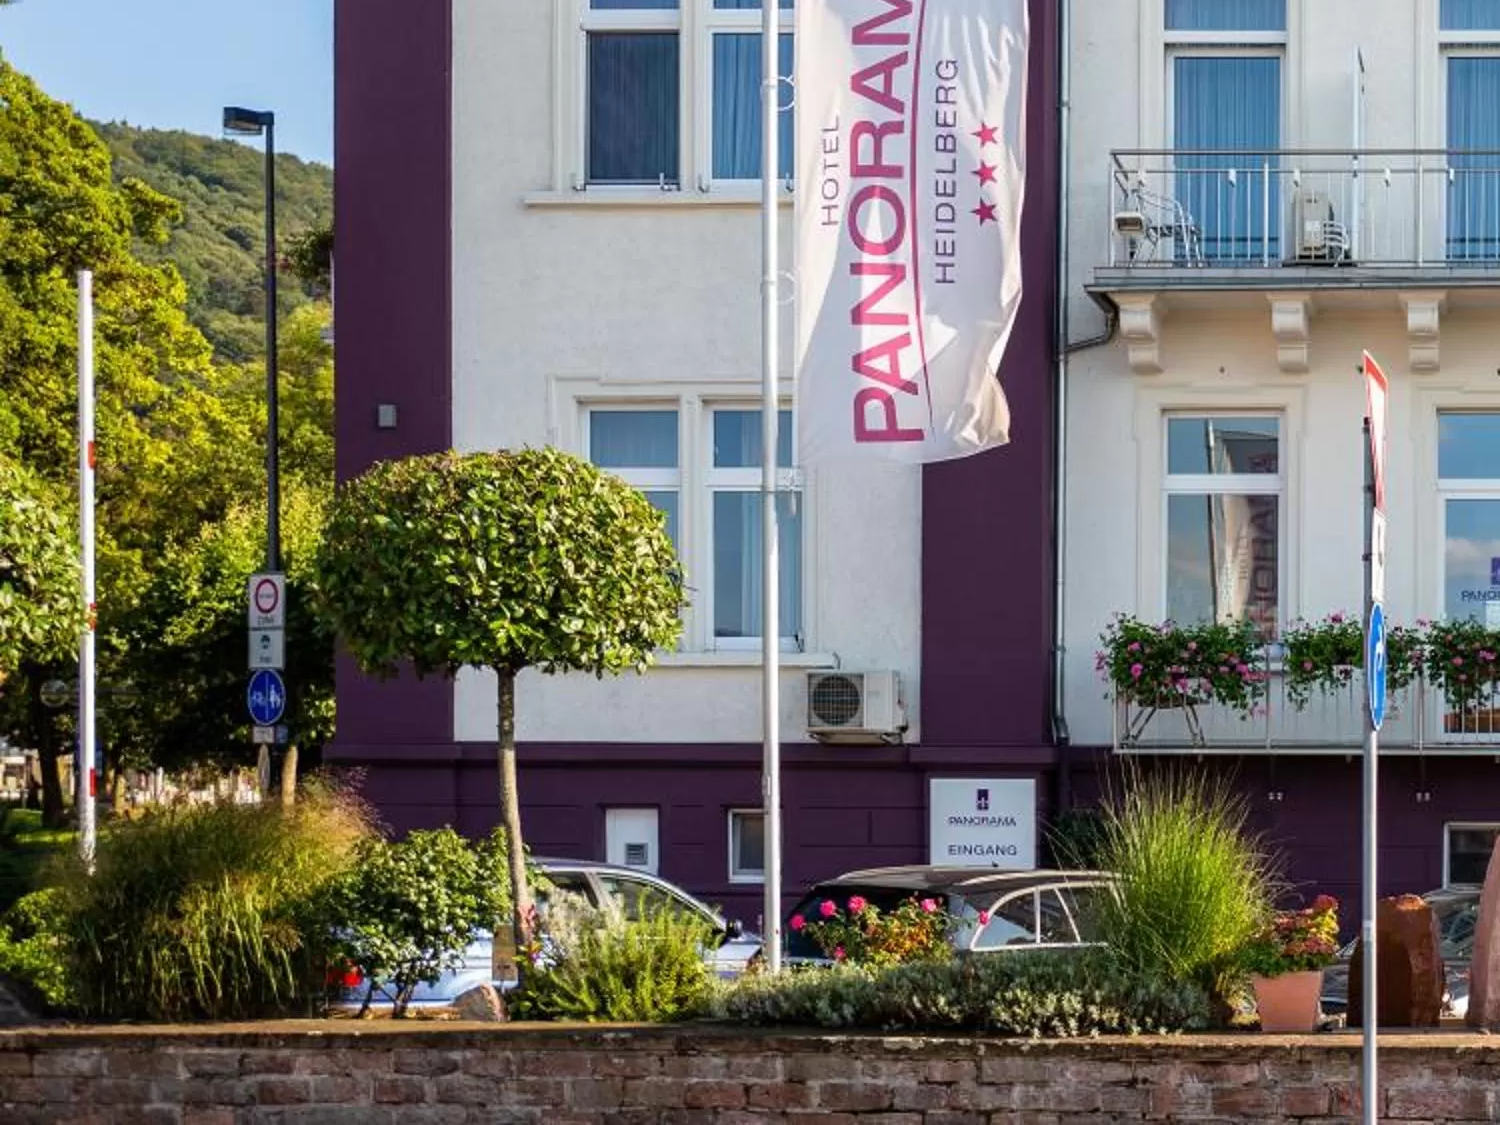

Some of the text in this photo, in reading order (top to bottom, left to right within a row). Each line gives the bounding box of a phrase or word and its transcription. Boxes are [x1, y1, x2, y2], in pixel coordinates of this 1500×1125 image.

[821, 115, 840, 227] HOTEL
[934, 58, 959, 285] HEIDELBERG
[947, 844, 1017, 856] EINGANG
[948, 816, 1017, 828] PANORAMA
